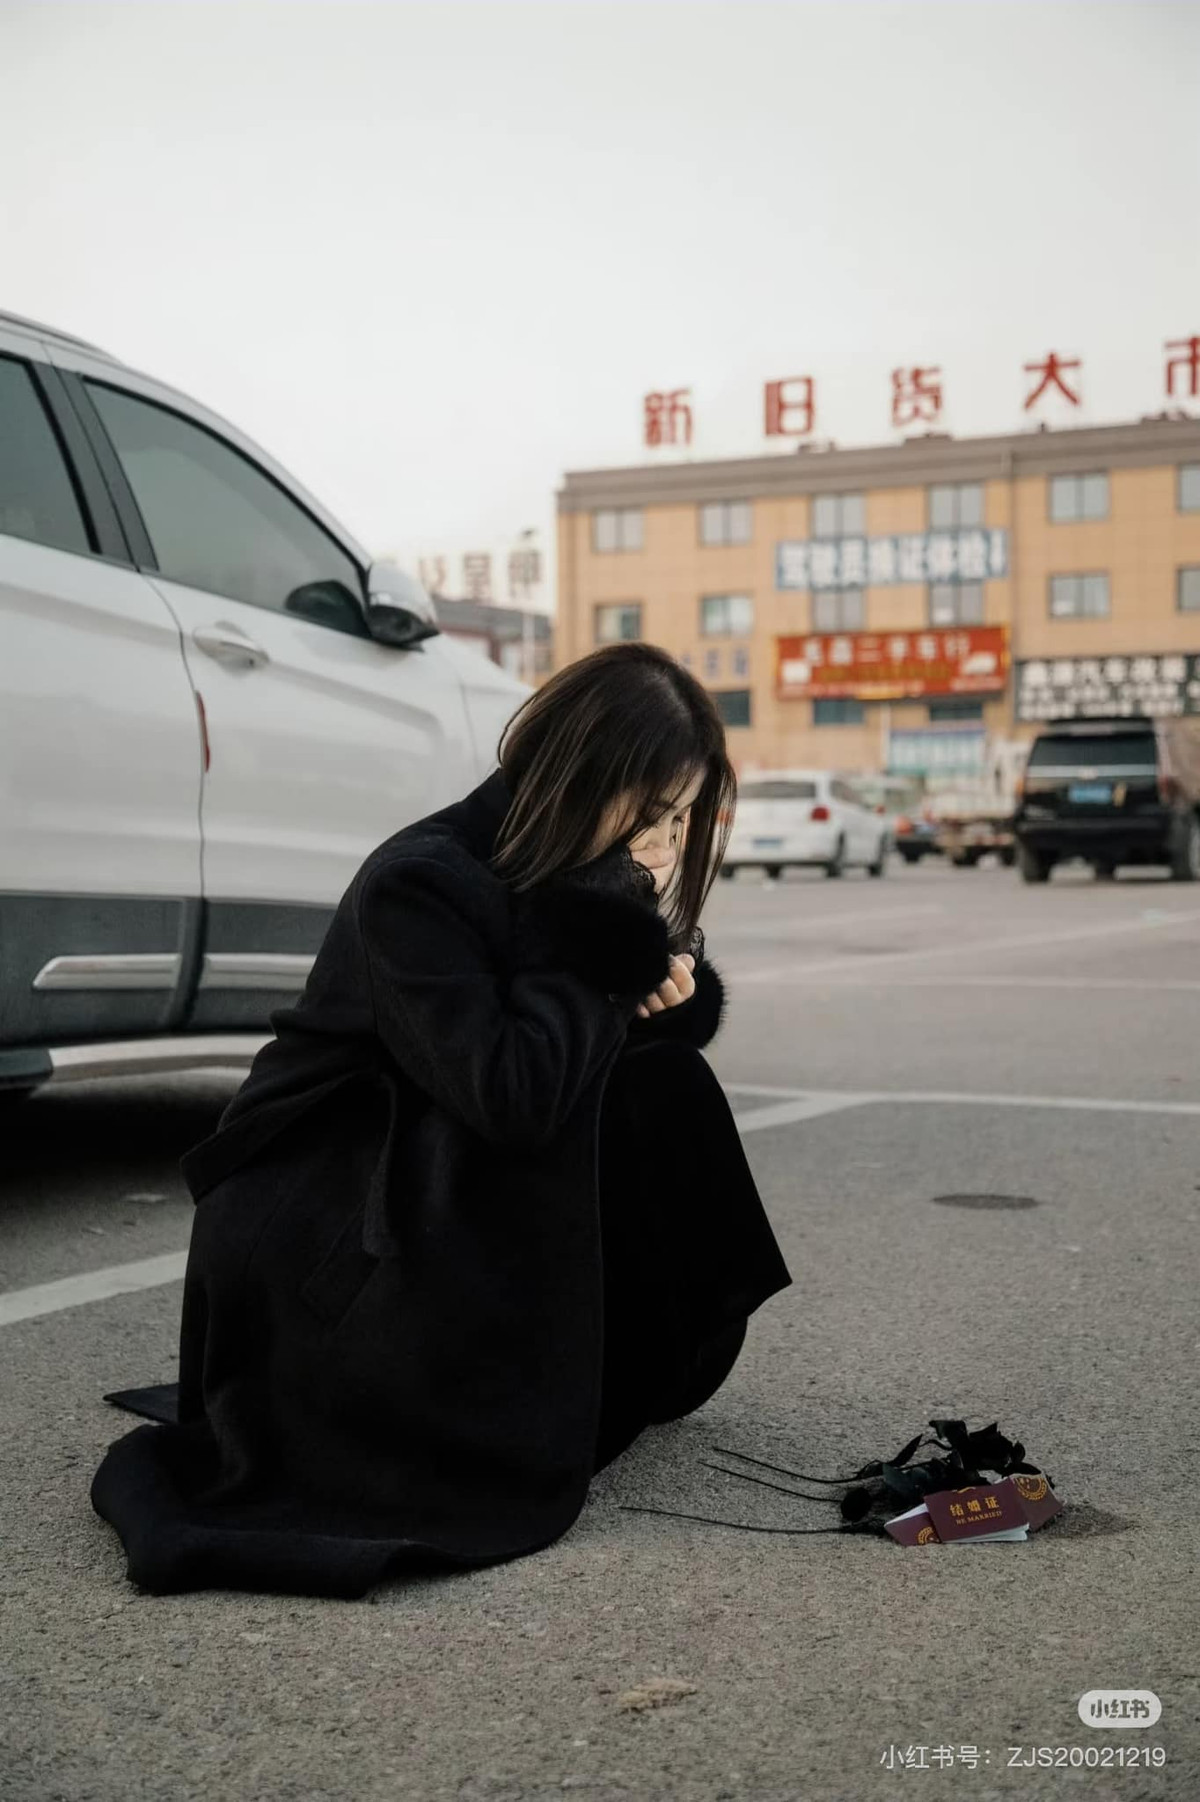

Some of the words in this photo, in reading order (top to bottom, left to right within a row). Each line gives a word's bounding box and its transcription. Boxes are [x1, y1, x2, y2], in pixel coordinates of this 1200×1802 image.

[644, 336, 1200, 447] 新旧货大市
[949, 1496, 1000, 1517] 结婚证
[967, 1511, 1002, 1522] MARRIED
